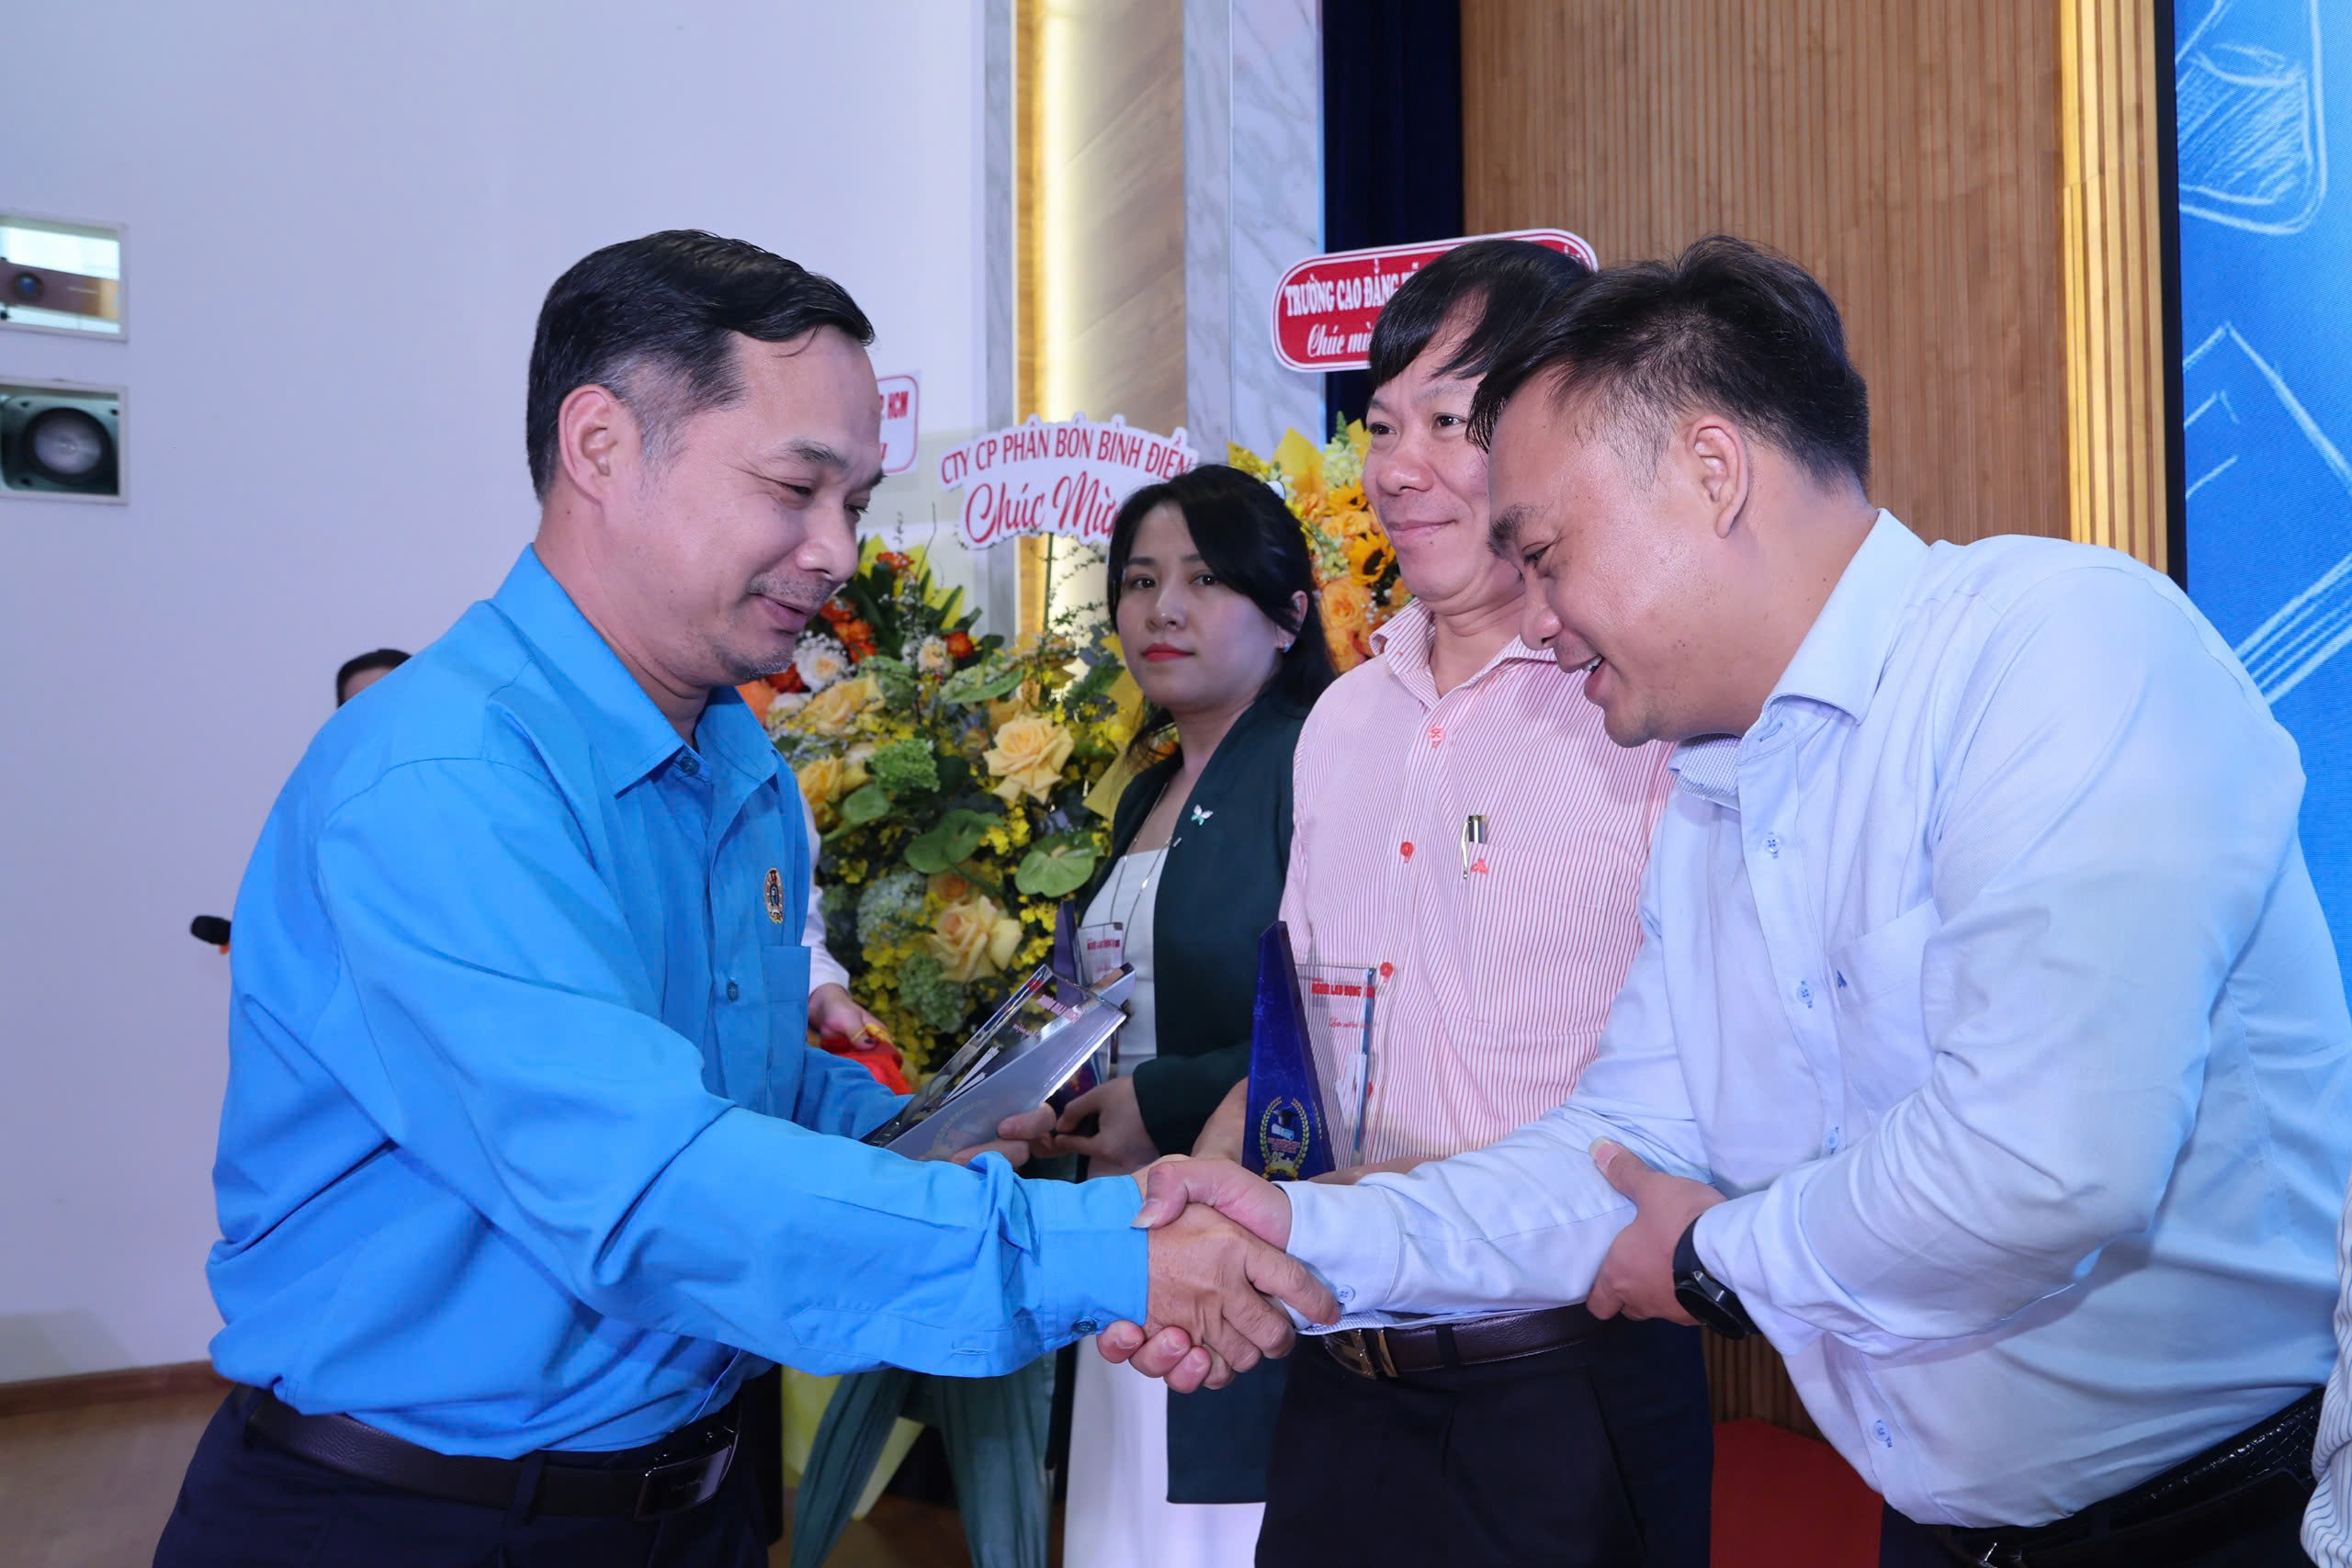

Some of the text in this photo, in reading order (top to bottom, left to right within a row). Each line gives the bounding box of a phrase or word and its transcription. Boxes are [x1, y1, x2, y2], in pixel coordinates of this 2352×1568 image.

[1284, 274, 1335, 317] TRƯỜNG
[1336, 277, 1362, 310] CAO
[1307, 321, 1374, 357] Chúc mừ
[941, 447, 971, 484] CTY
[976, 439, 997, 470] CP
[1002, 421, 1051, 464] PHÂN
[1055, 418, 1094, 460] BÓN
[1097, 422, 1144, 469] BÌNH
[966, 470, 1117, 544] Chúc Mừ
